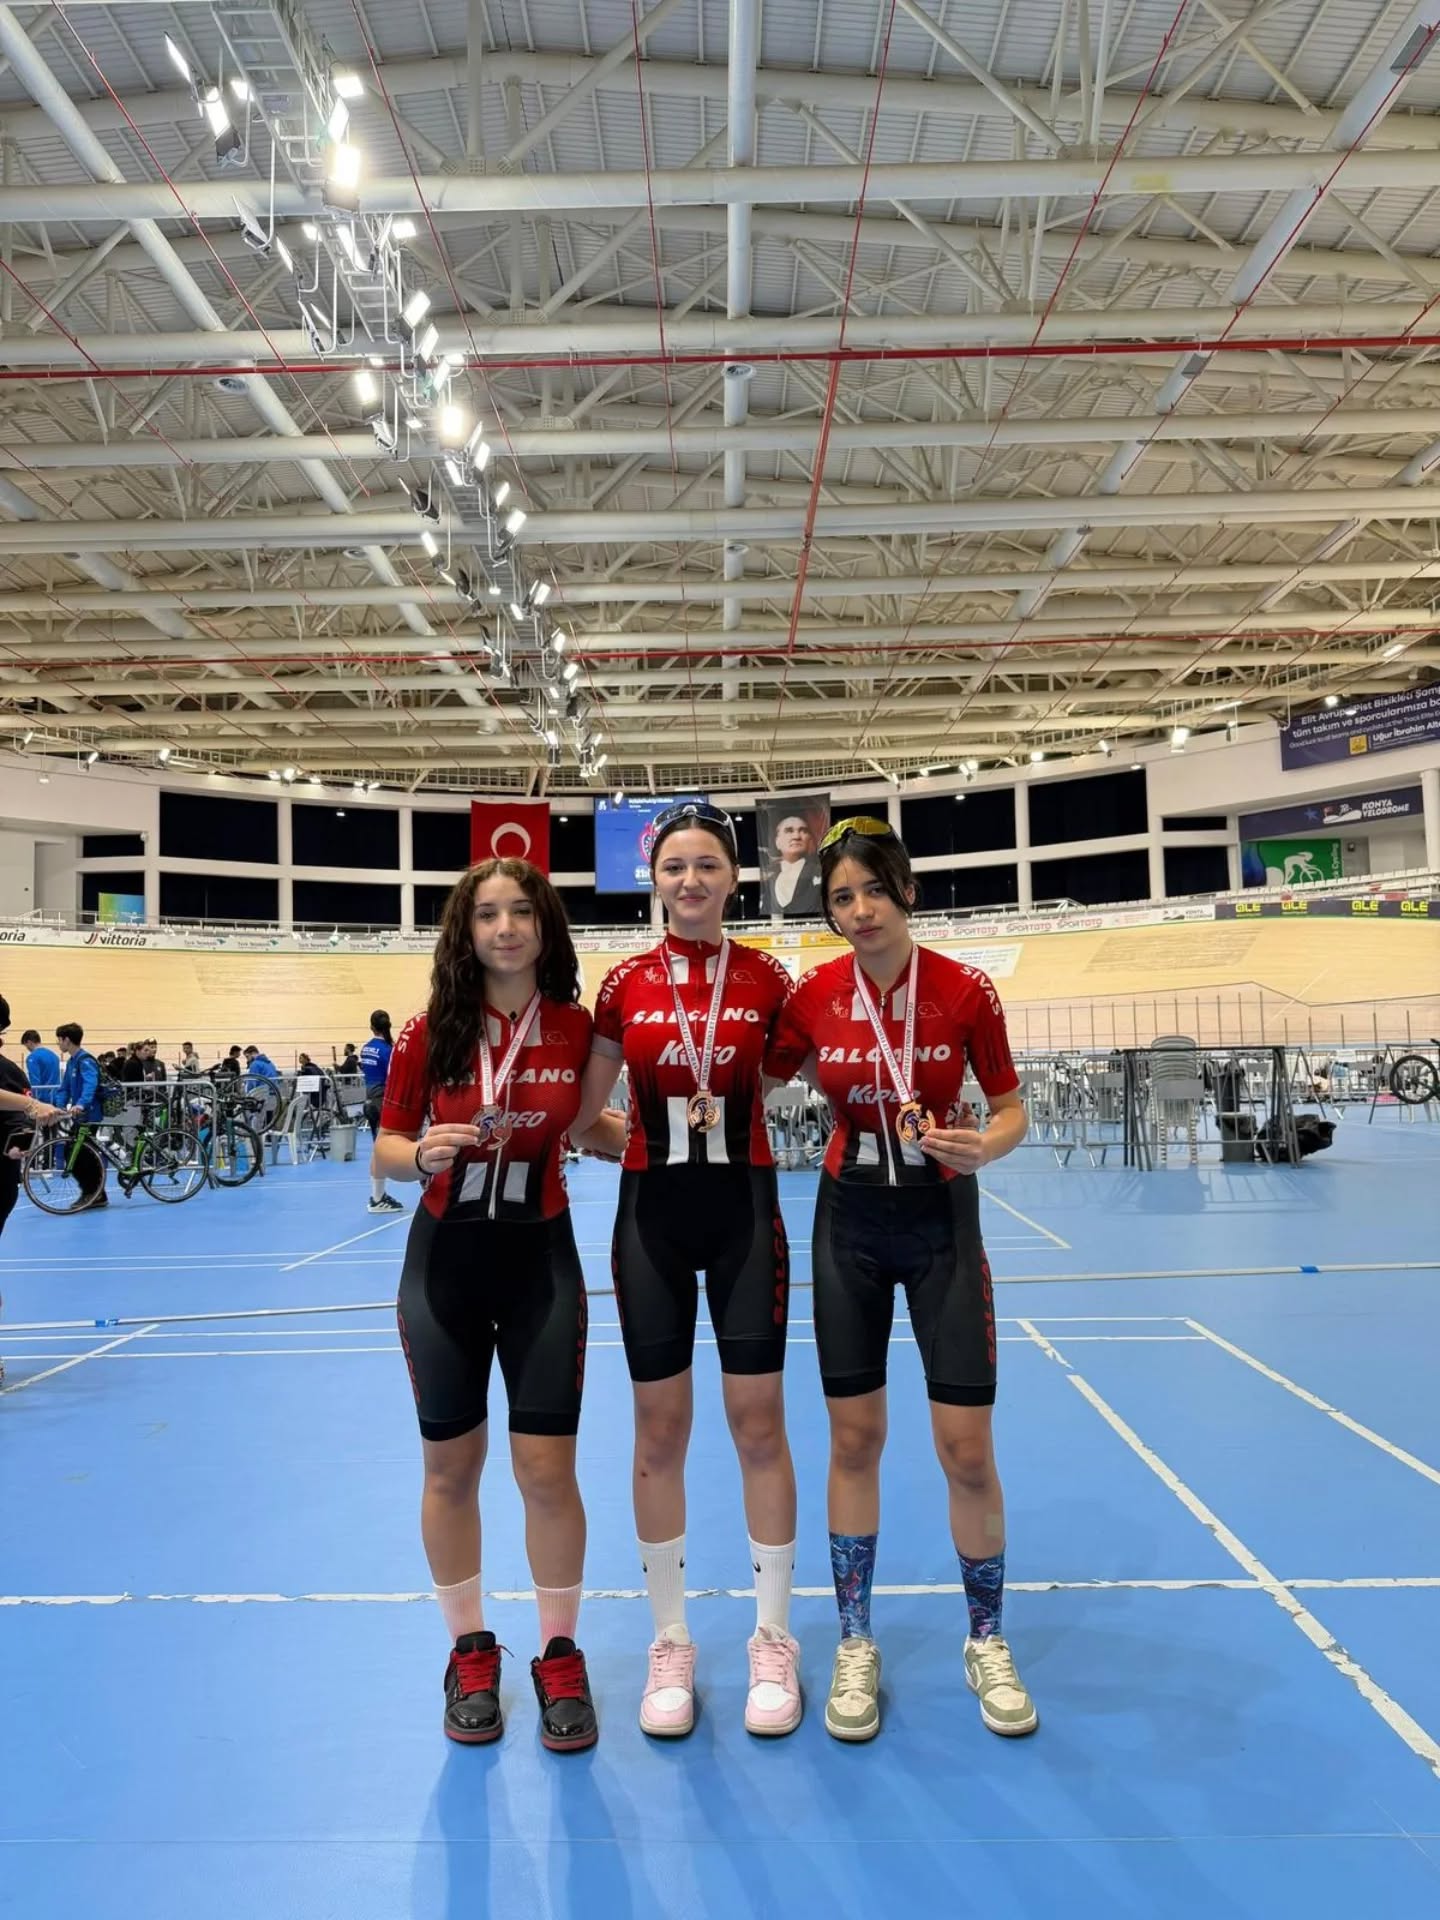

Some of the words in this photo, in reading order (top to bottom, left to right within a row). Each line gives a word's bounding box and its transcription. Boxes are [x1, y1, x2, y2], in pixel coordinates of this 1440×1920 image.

[1301, 714, 1317, 725] Elit
[1319, 708, 1346, 720] Avrup
[1292, 728, 1311, 738] tüm
[1313, 721, 1340, 734] takım
[1341, 718, 1353, 727] ve
[1362, 799, 1393, 810] KONYA
[1362, 803, 1409, 817] VELODROME
[99, 932, 147, 946] vittoria
[601, 960, 640, 1004] SIVAS
[960, 965, 1001, 1016] SIVAS
